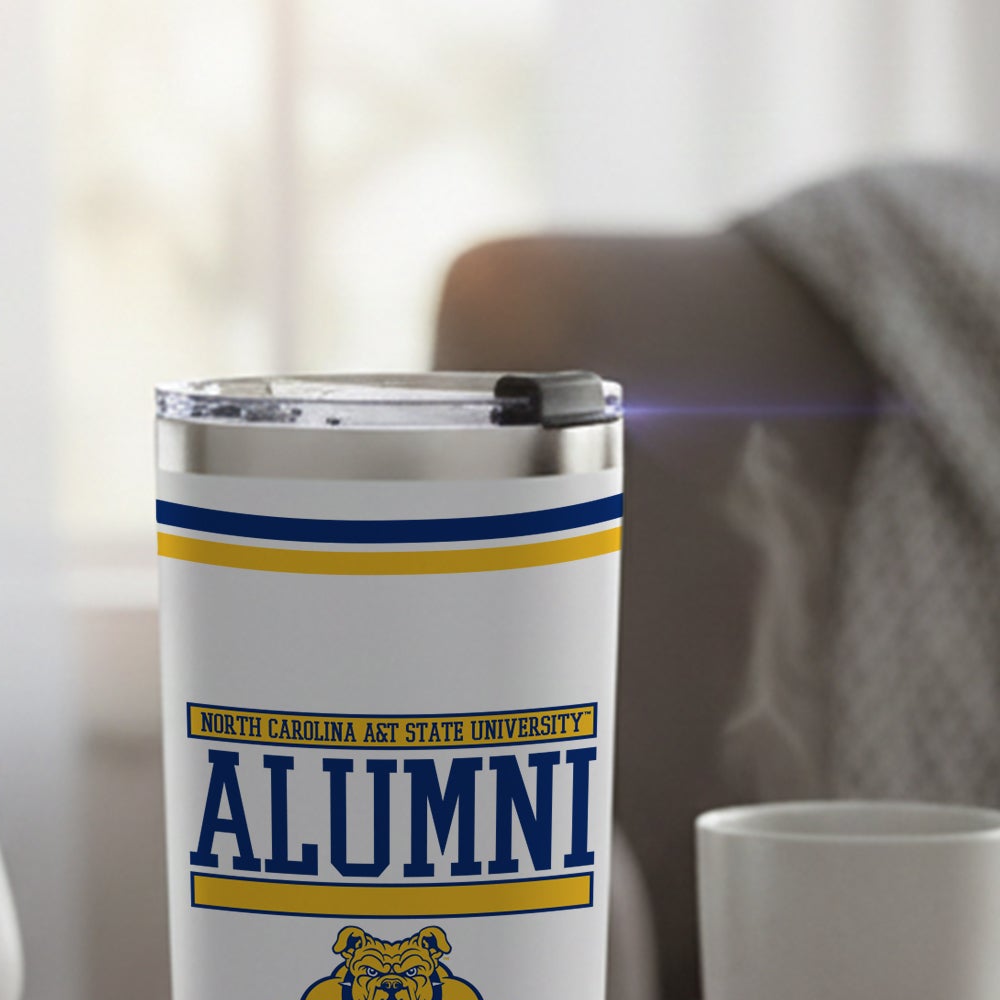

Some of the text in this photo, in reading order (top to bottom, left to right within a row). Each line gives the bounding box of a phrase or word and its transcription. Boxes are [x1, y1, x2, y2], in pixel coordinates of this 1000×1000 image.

[200, 712, 261, 737] NORTH
[268, 718, 357, 742] CAROLINA
[363, 722, 399, 743] A&T
[405, 721, 463, 742] STATE
[190, 746, 597, 877] ALUMNI
